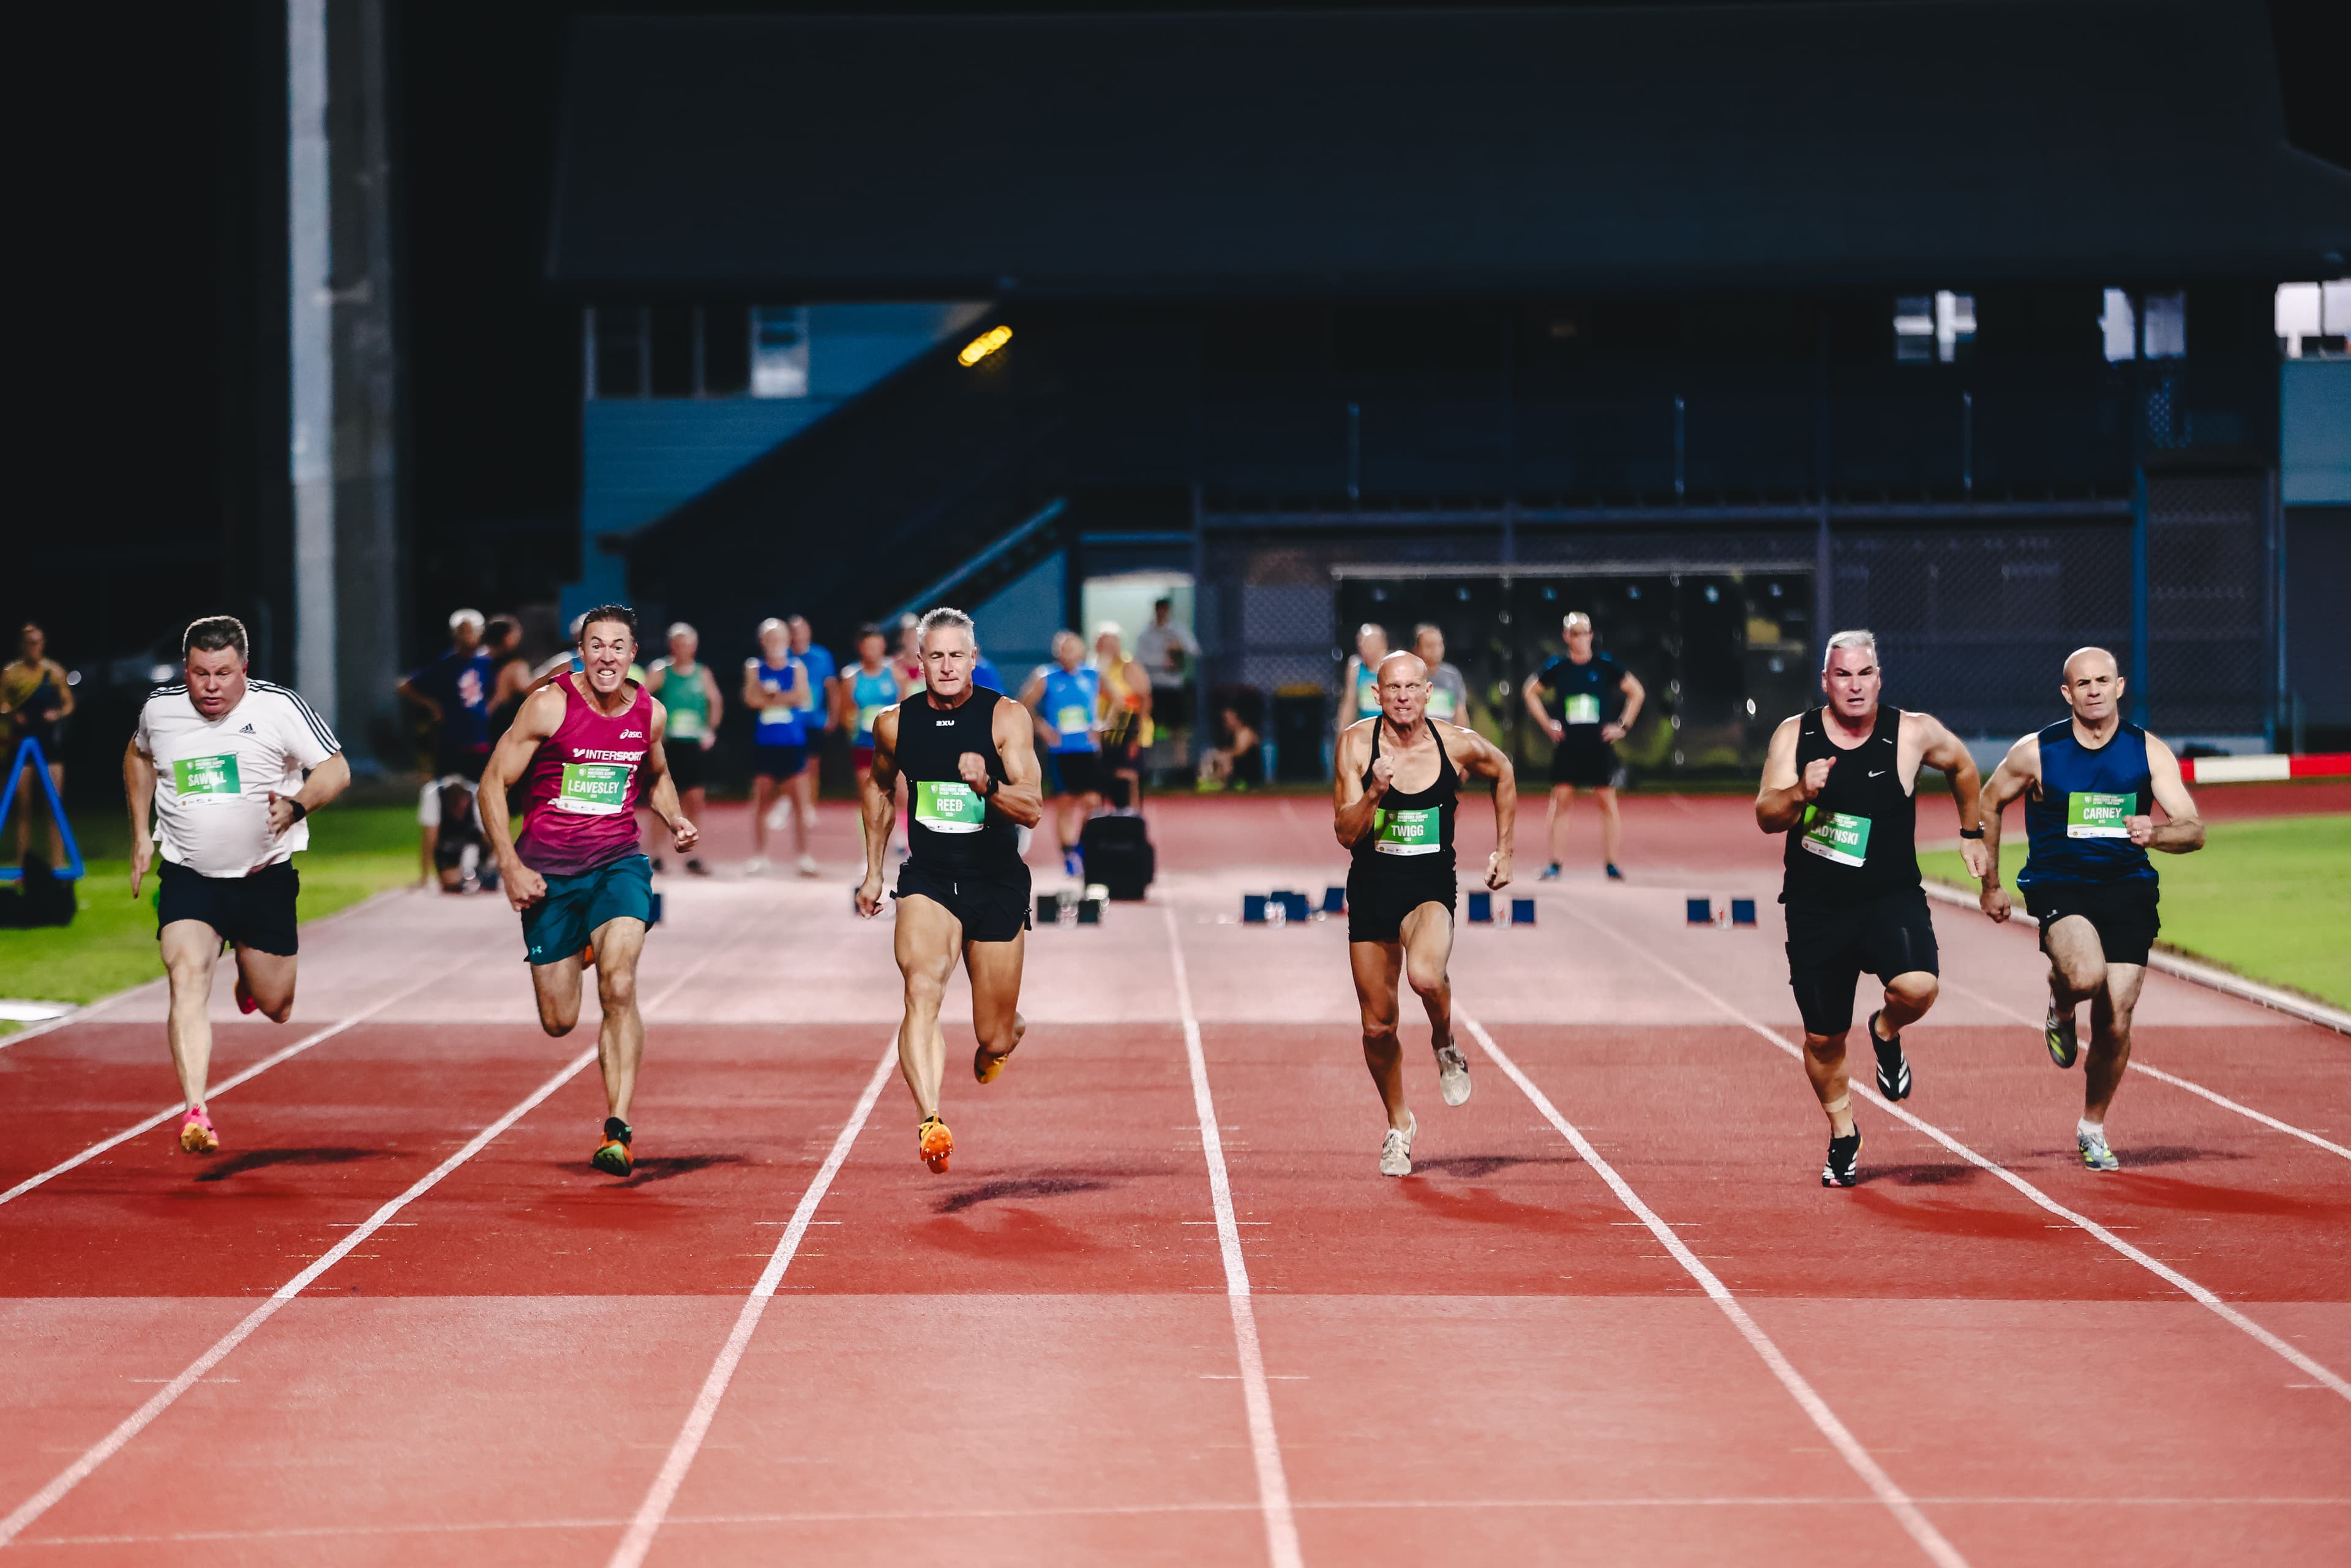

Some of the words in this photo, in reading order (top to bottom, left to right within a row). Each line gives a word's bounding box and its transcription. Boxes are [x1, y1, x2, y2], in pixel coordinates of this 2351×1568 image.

[585, 749, 643, 761] INTERSPORT
[568, 780, 620, 794] LEAVESLEY
[937, 798, 963, 812] REED
[2083, 807, 2122, 820] CARNEY
[1391, 824, 1424, 837] TWIGG
